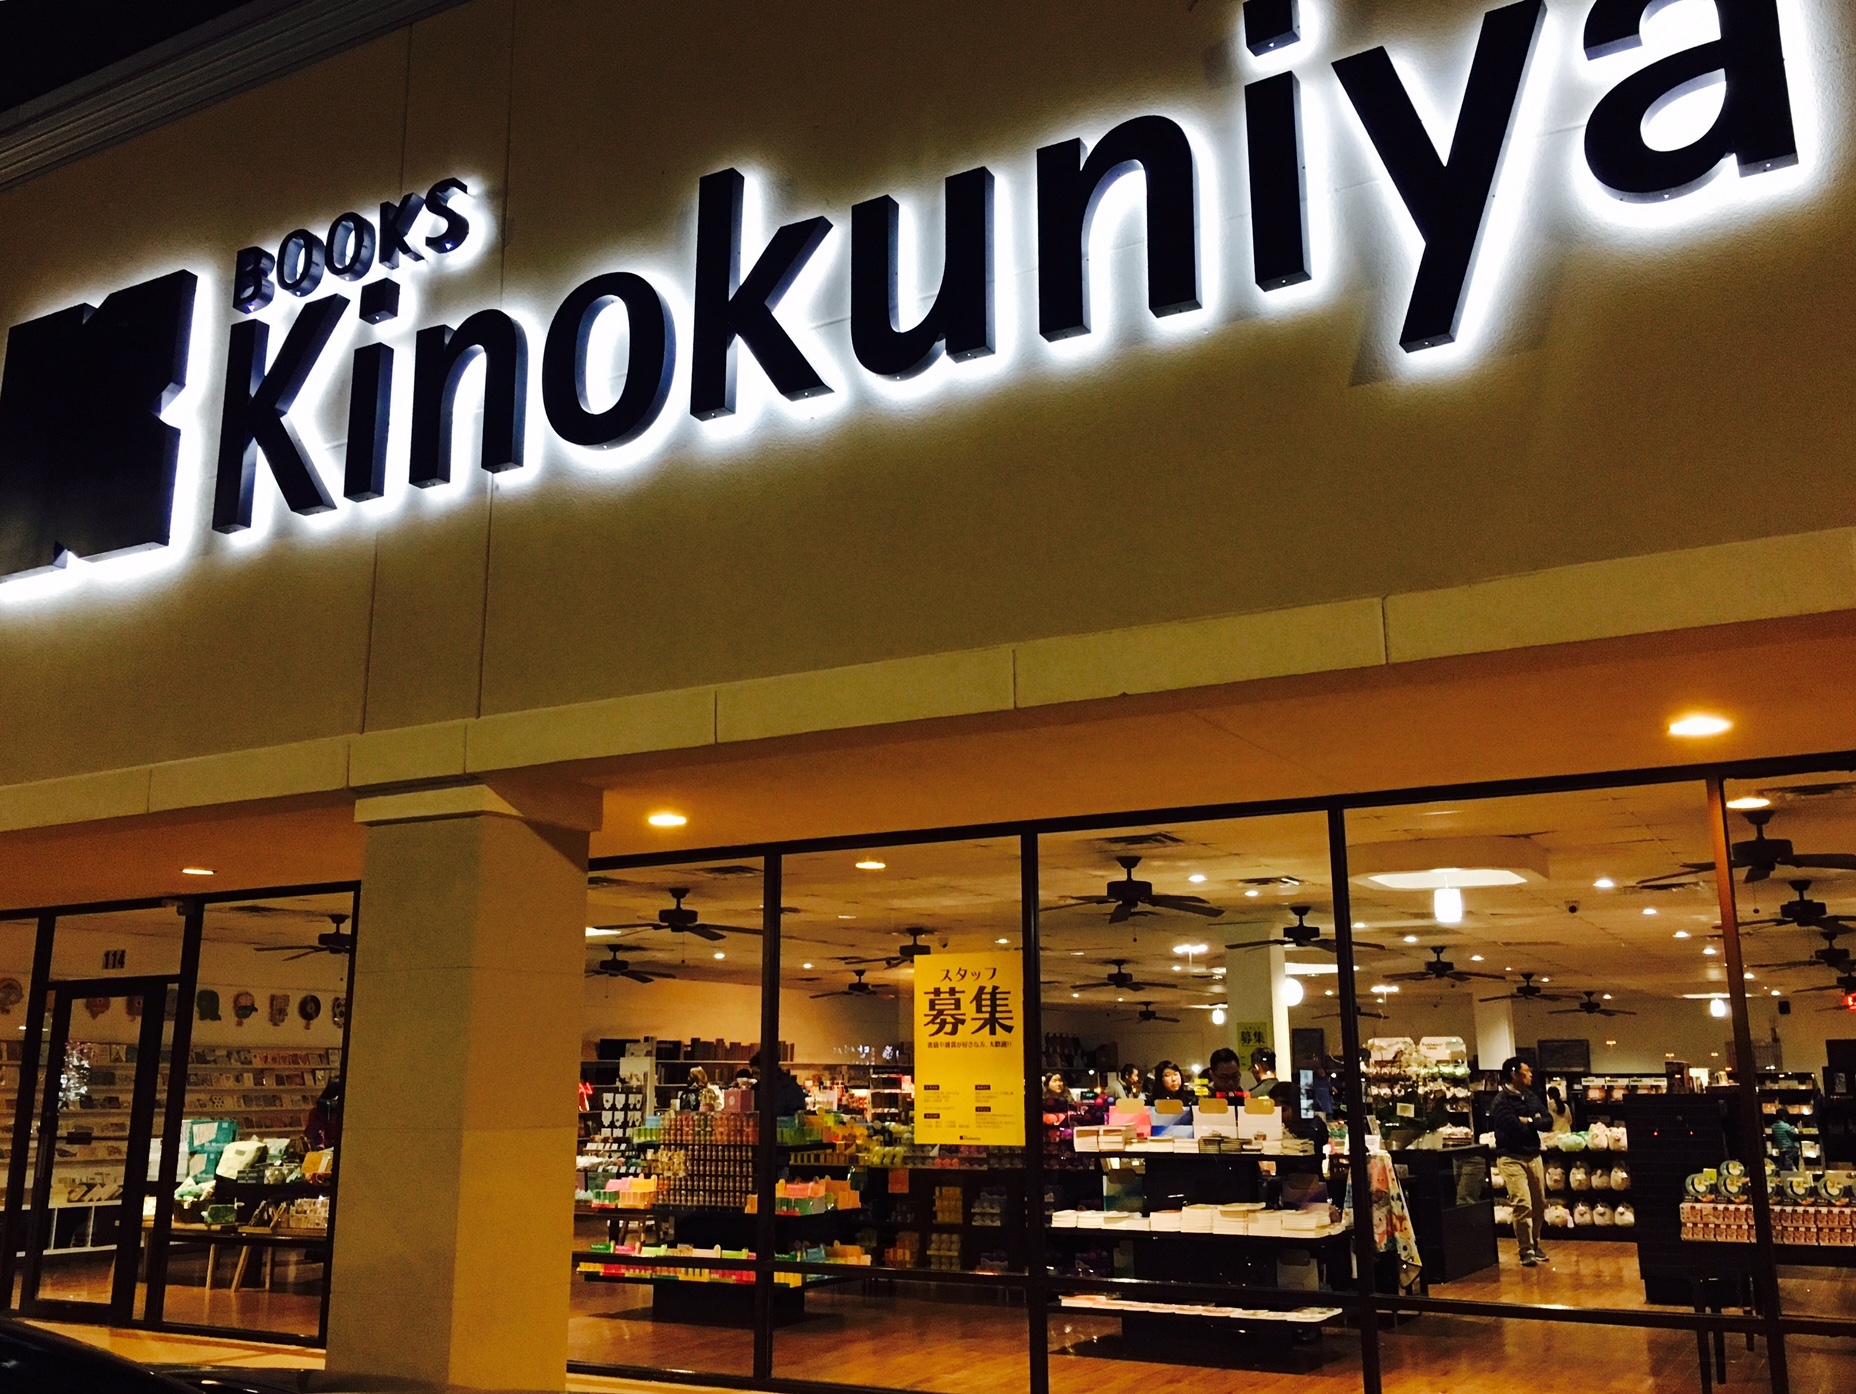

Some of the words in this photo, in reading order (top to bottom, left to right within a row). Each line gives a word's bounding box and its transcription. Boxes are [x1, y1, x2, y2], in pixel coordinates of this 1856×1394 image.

[212, 0, 1799, 534] Kinokuniya
[233, 177, 470, 313] BOOKS
[103, 949, 126, 970] 114
[940, 967, 997, 983] スタッフ
[924, 985, 1015, 1037] 募集
